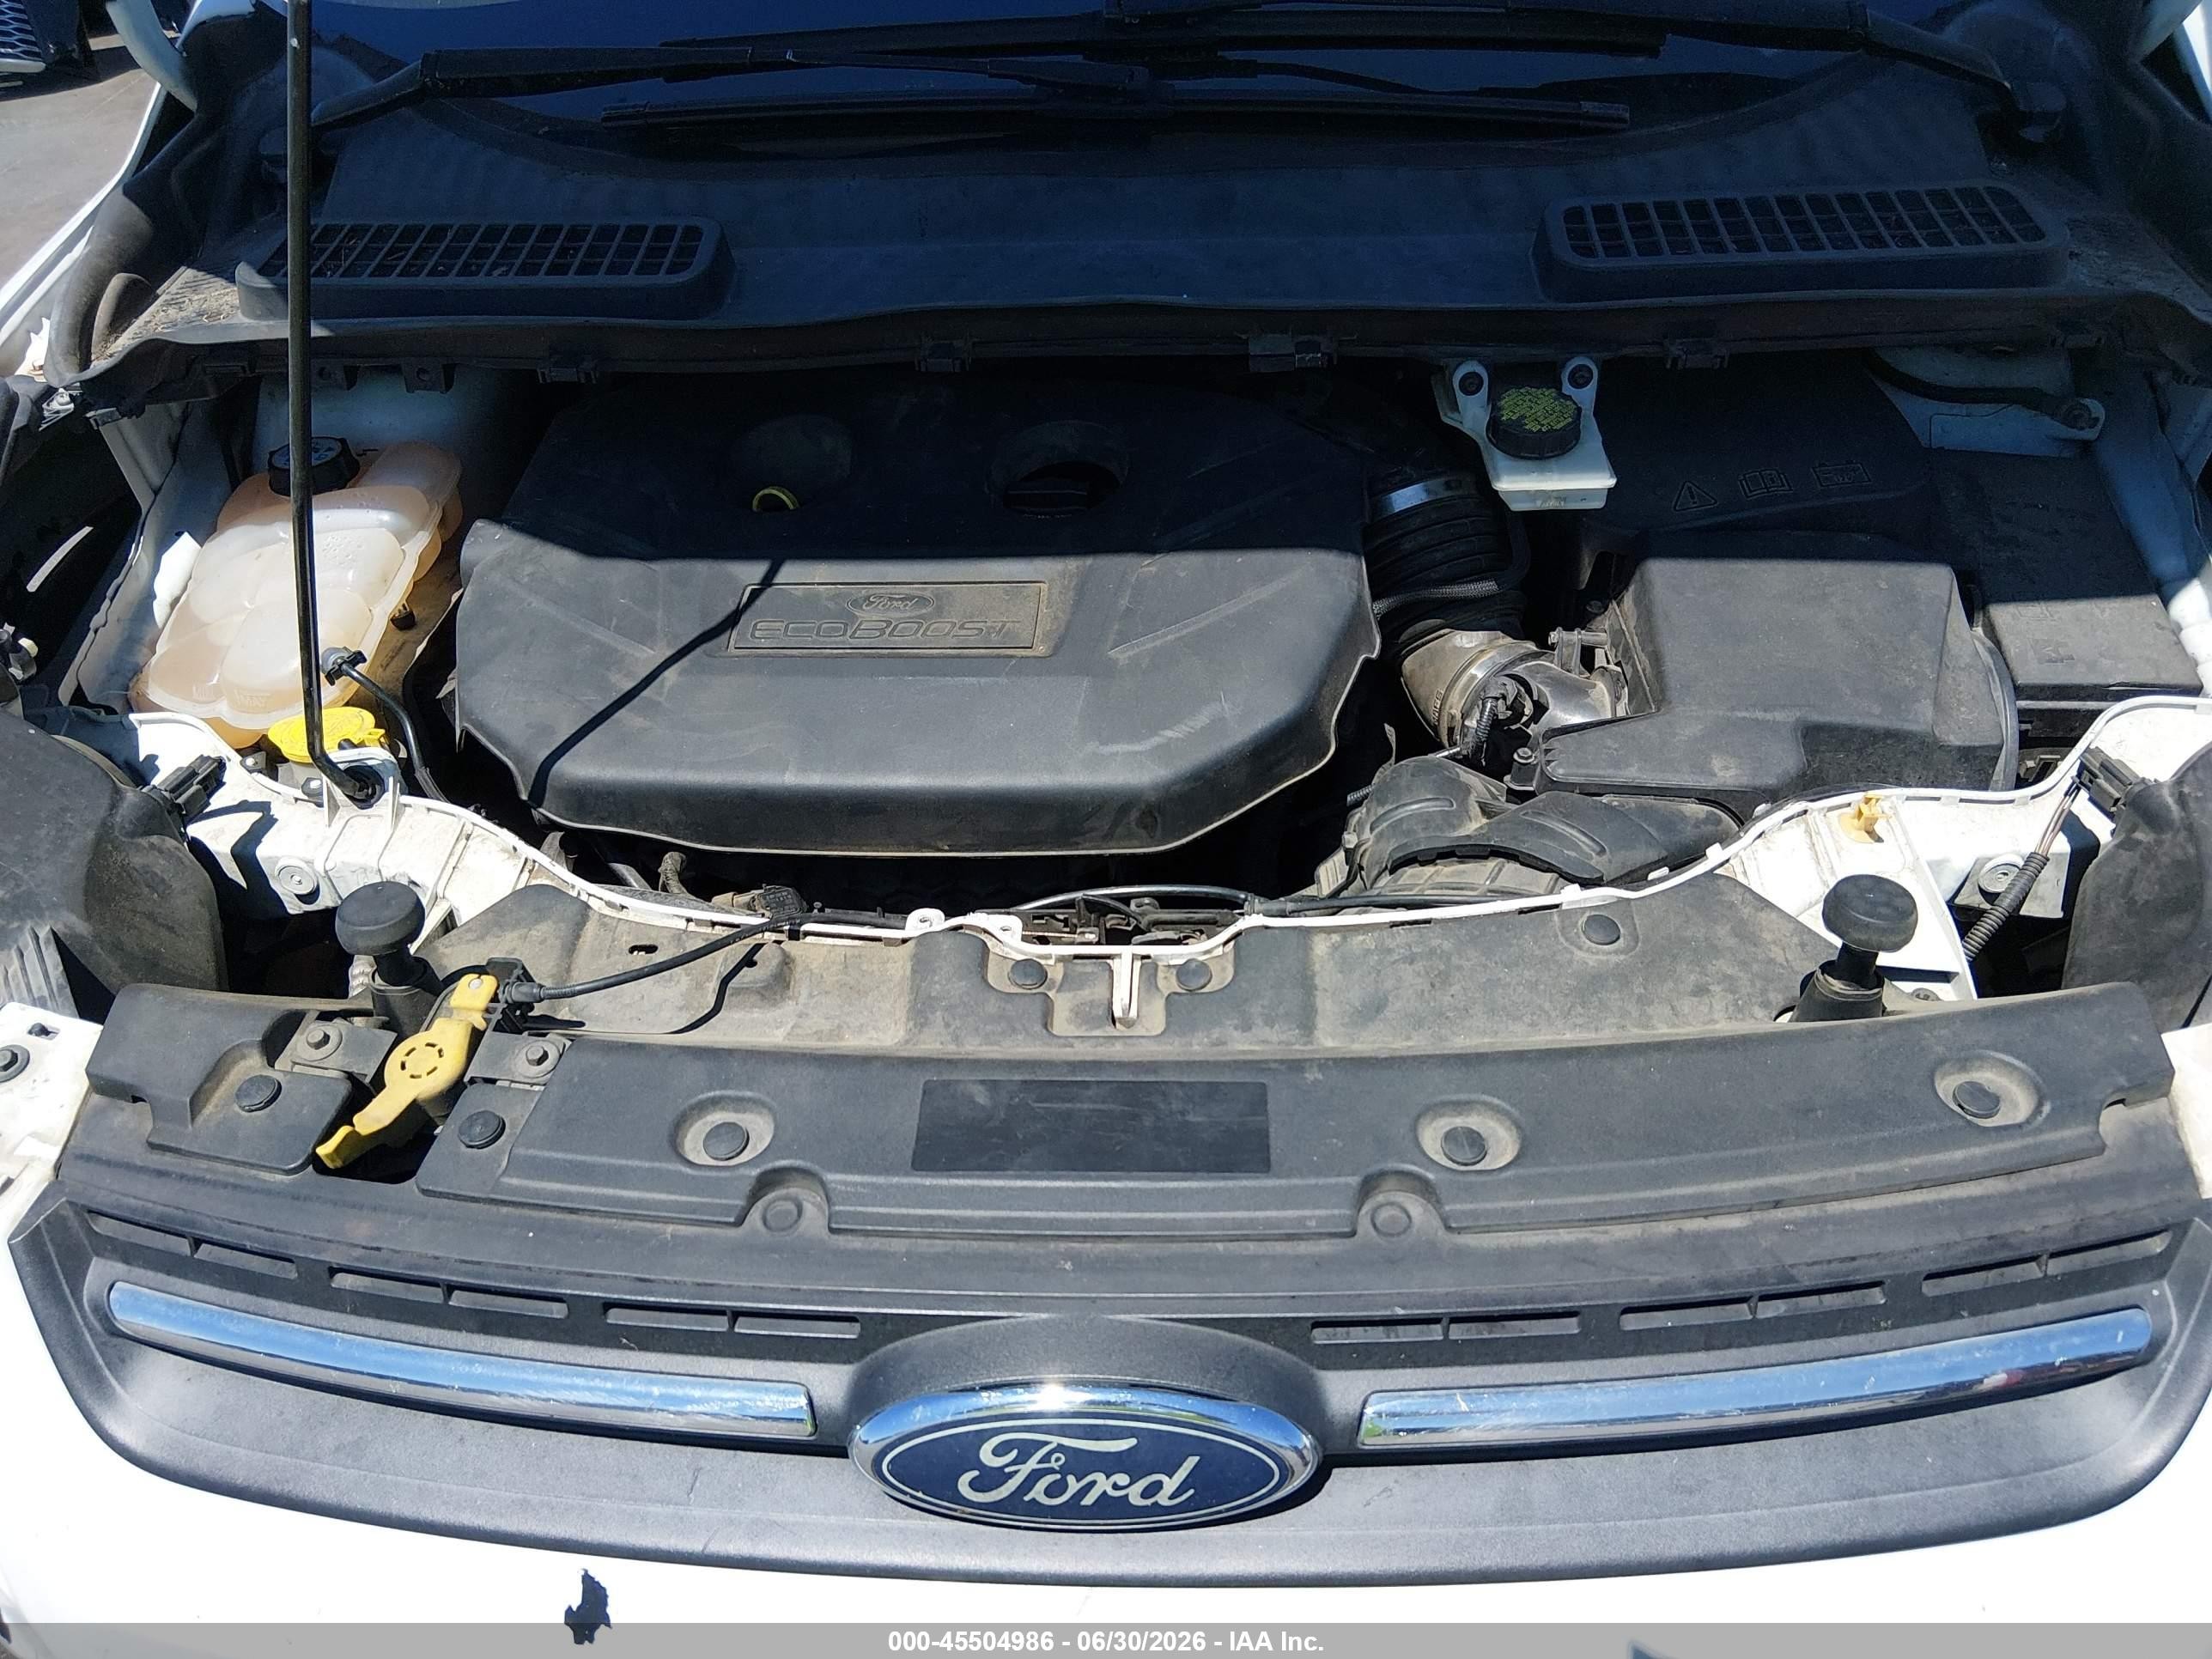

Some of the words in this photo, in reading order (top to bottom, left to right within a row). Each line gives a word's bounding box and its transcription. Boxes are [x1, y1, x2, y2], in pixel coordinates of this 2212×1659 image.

[862, 593, 919, 611] Ford
[750, 618, 1022, 640] ECOBOOST
[957, 1431, 1200, 1507] Ford
